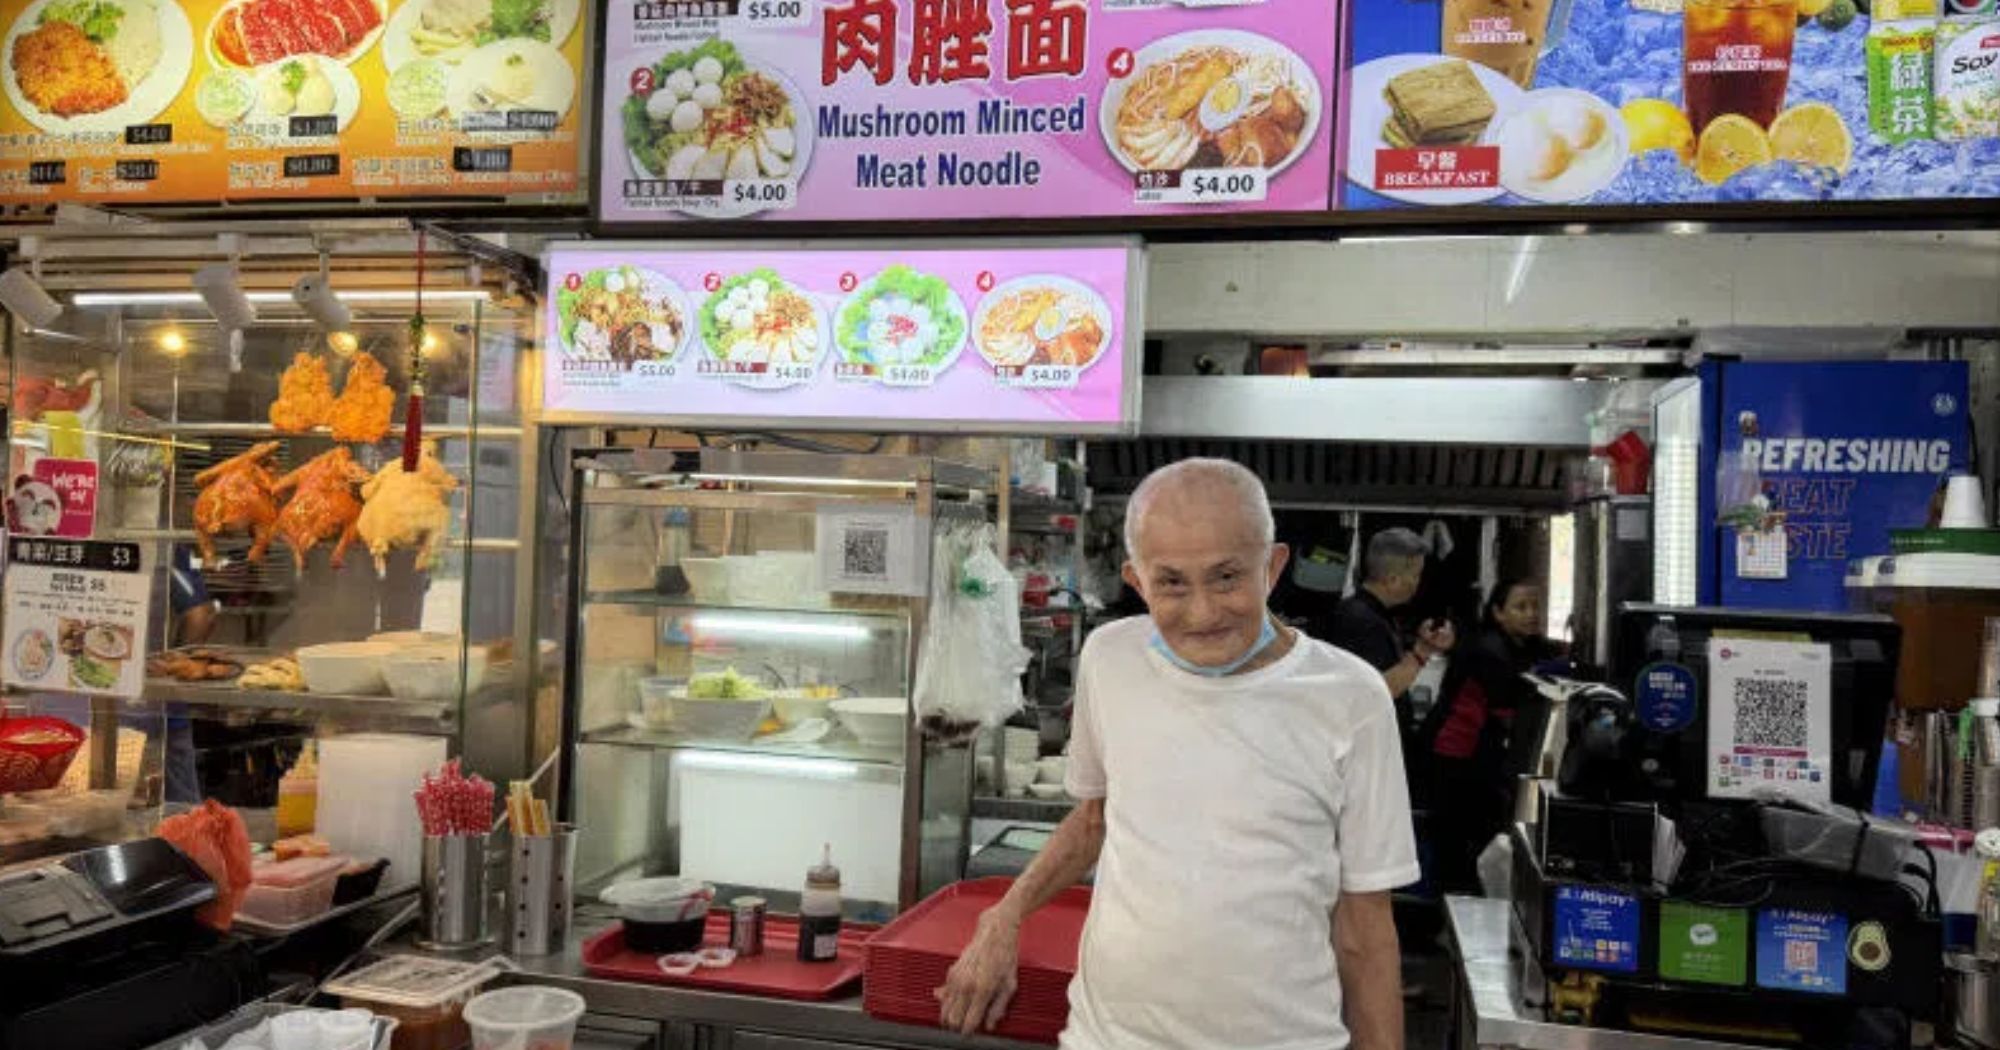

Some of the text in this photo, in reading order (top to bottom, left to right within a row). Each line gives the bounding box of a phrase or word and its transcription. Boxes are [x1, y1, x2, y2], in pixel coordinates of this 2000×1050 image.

[749, 2, 800, 19] $5.00
[1113, 52, 1128, 71] 4
[1952, 52, 1998, 74] Soy
[636, 71, 649, 91] 2
[818, 97, 1085, 137] Mushroom Minced
[857, 151, 1041, 188] Meat Noodle
[1384, 170, 1490, 186] BREAKFAST
[735, 183, 786, 203] $4.00
[1193, 174, 1255, 196] $4.00
[1741, 437, 1950, 473] REFRESHING
[112, 547, 131, 567] $3
